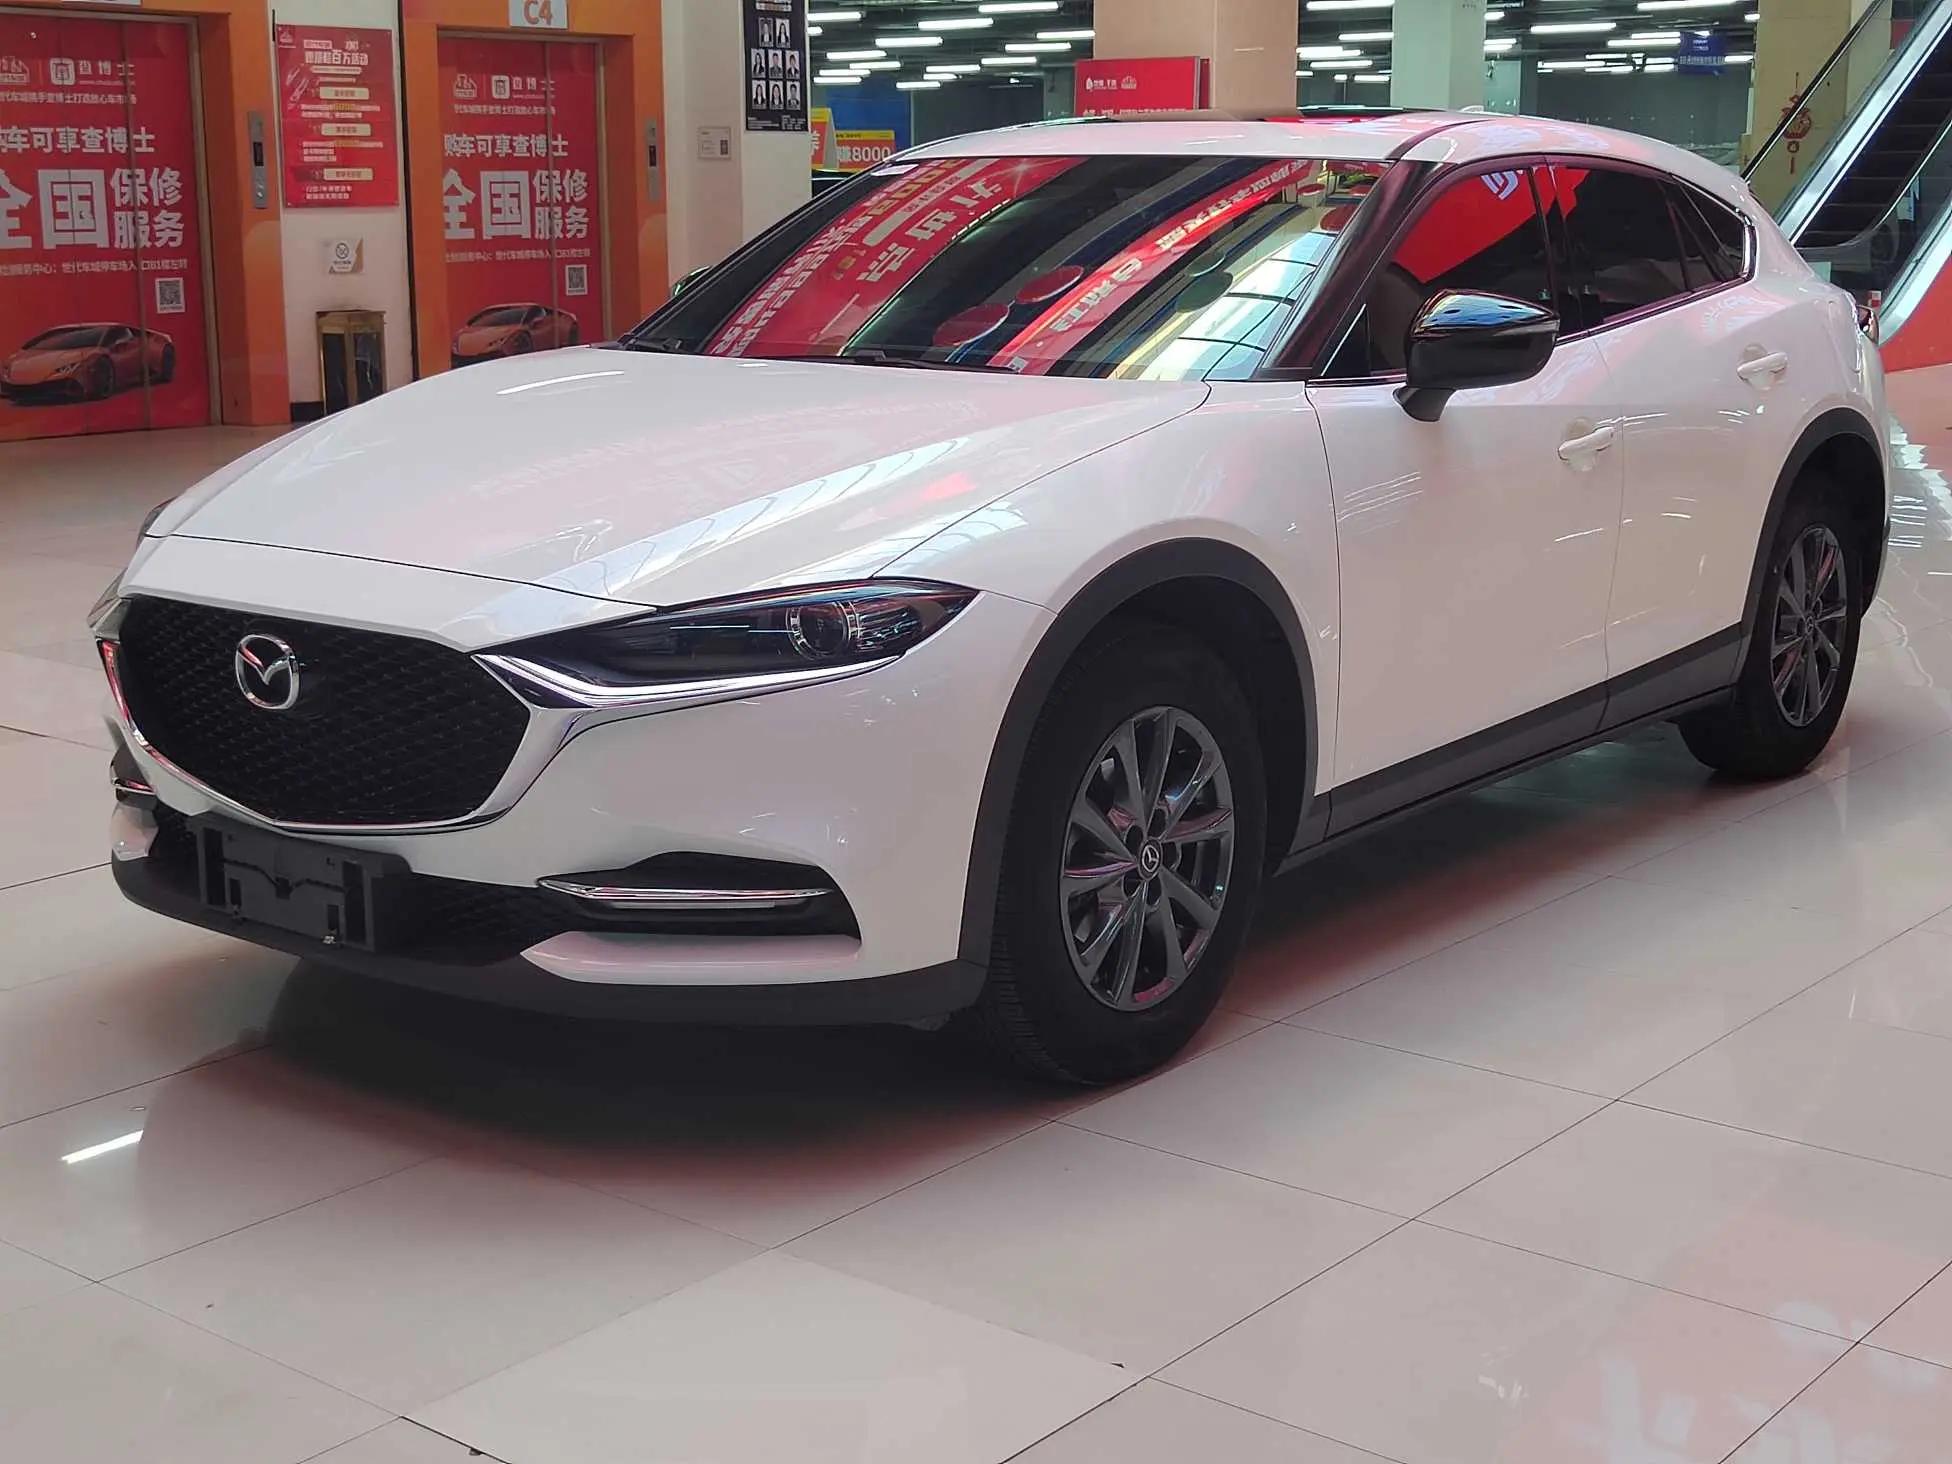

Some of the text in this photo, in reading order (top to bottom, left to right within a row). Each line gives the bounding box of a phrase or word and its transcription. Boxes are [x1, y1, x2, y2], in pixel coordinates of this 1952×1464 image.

[524, 0, 553, 25] C4
[444, 133, 569, 158] 购车可享查博士
[110, 166, 184, 207] 保修
[533, 168, 588, 203] 保修
[443, 168, 532, 240] 全国
[113, 209, 185, 249] 服务
[535, 205, 590, 240] 服务
